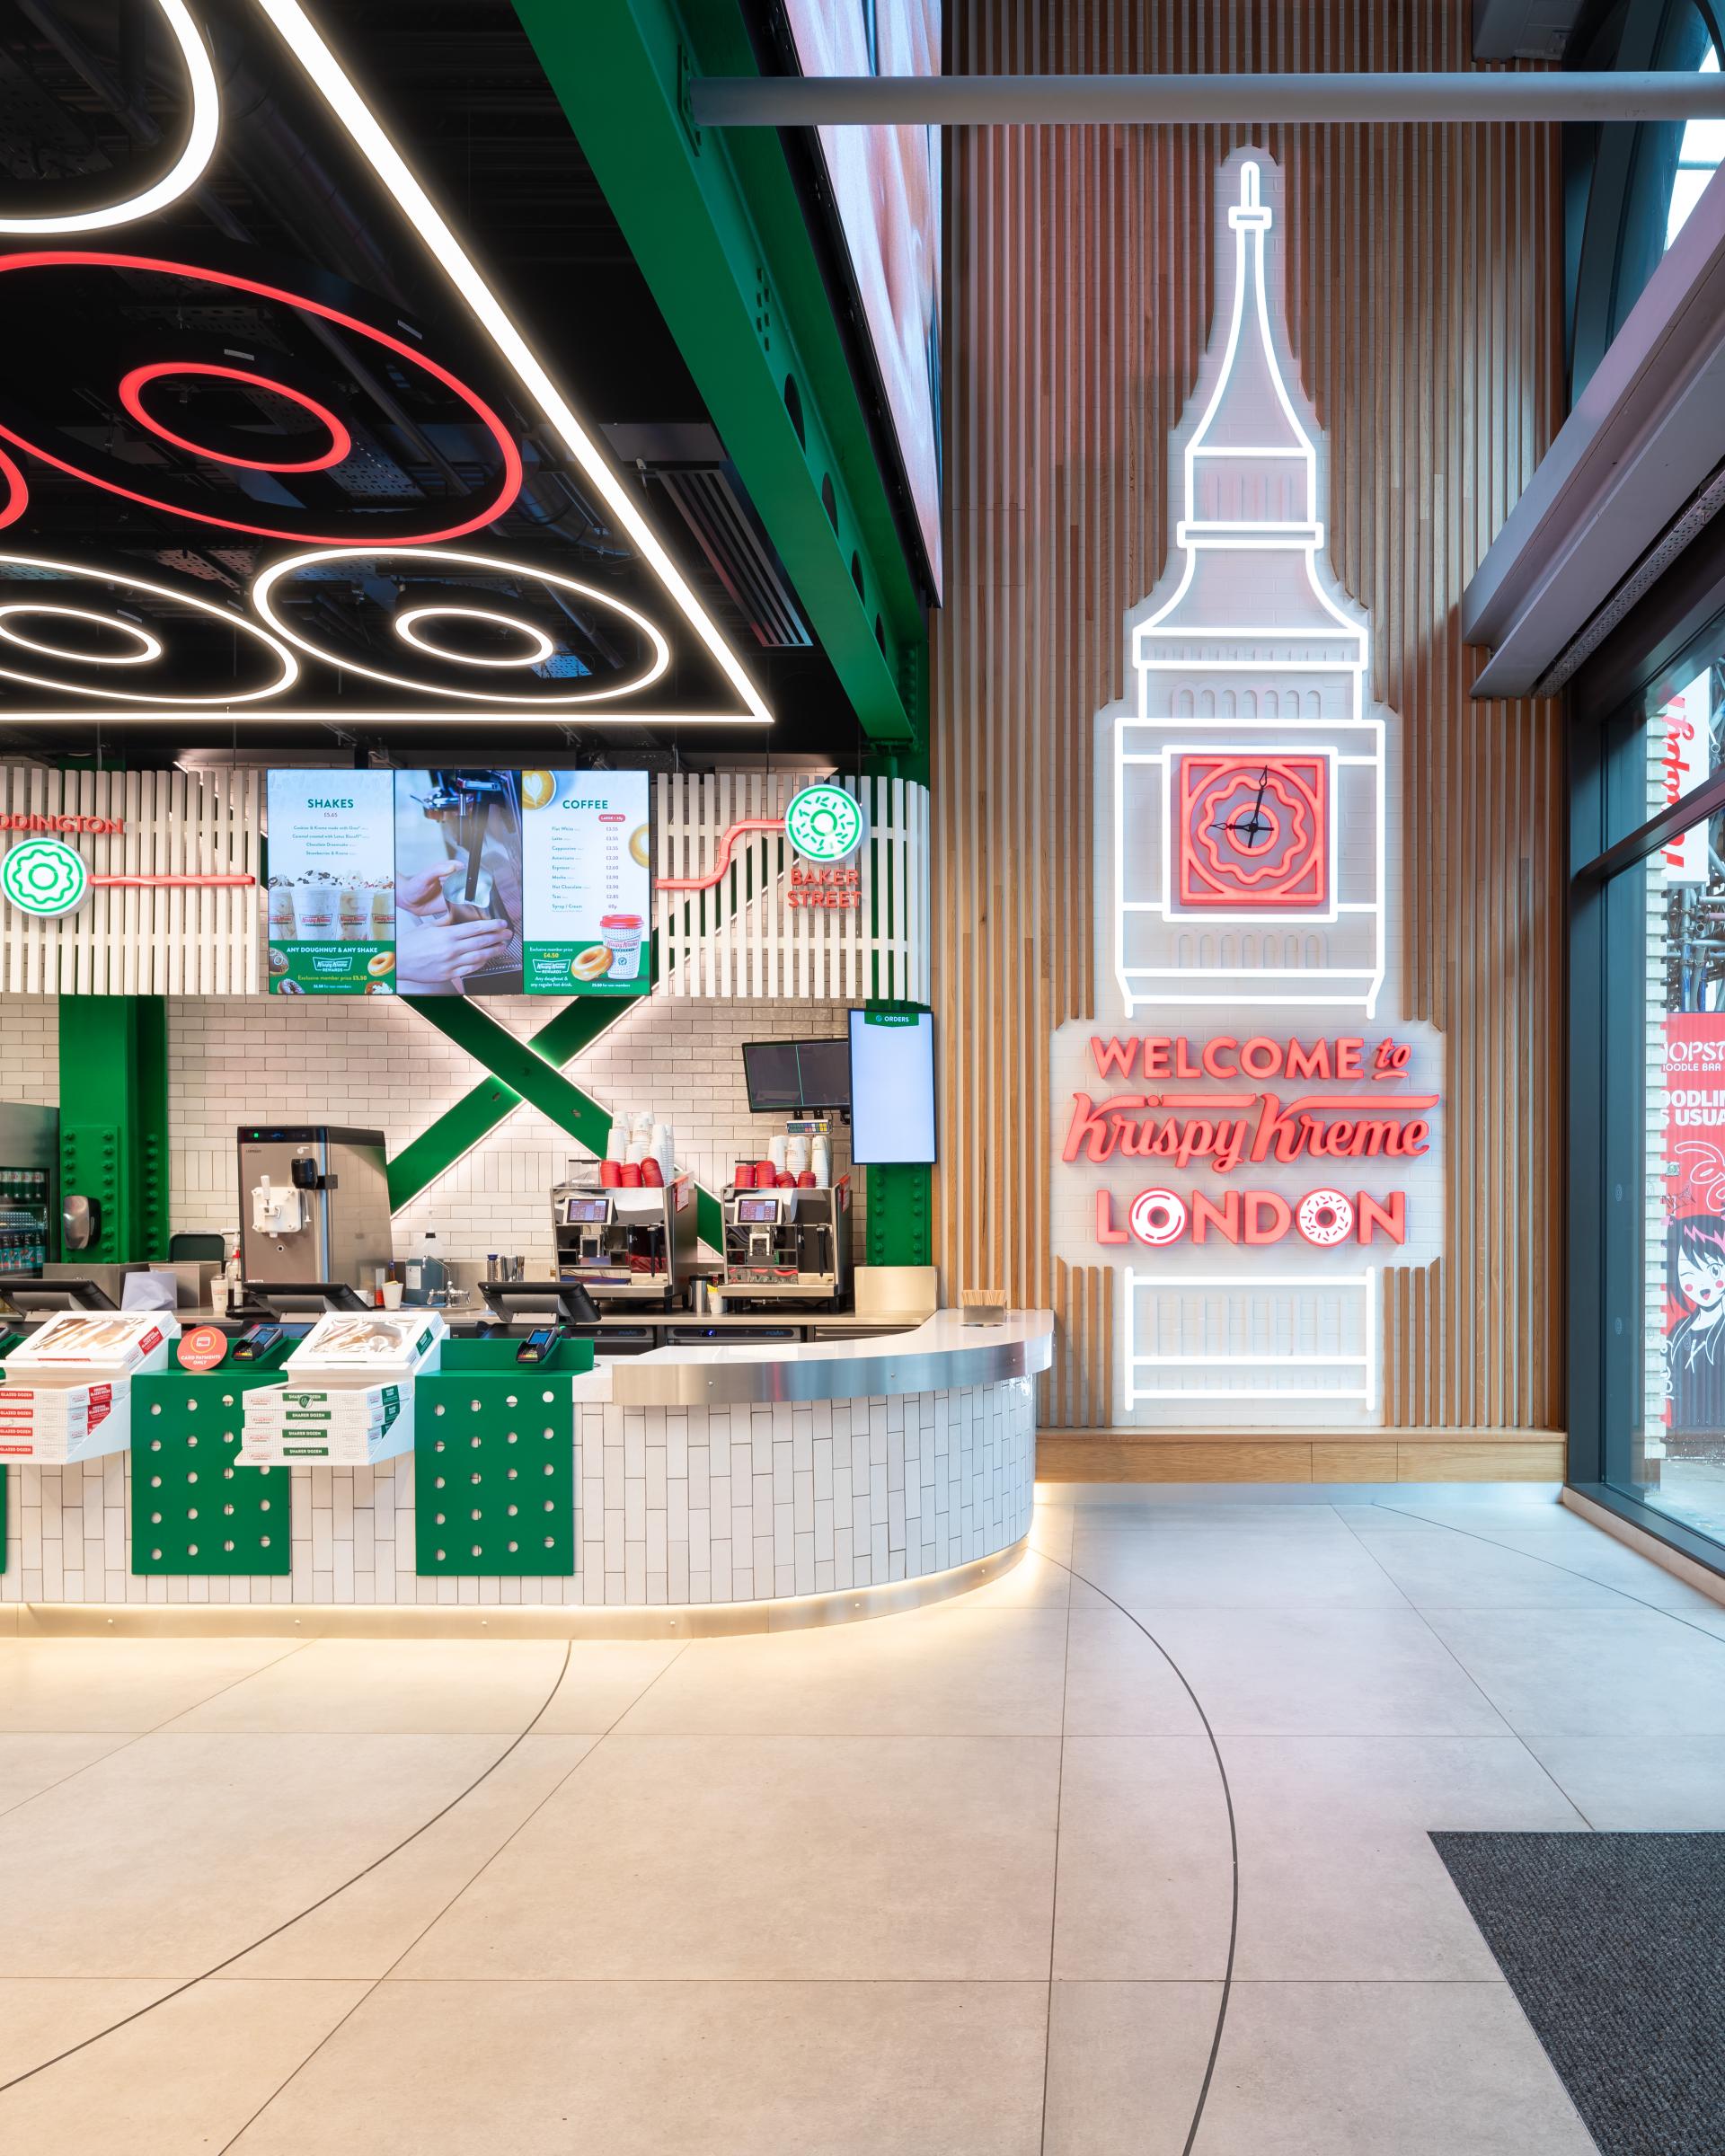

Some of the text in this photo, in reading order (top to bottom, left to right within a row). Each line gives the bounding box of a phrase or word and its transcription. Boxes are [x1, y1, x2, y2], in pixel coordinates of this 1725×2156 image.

[307, 799, 354, 808] SHAKES
[562, 800, 608, 808] COFFEE
[791, 868, 859, 887] BAKER
[787, 890, 862, 908] STREET
[1090, 1036, 1412, 1079] WELCOME to
[1702, 1063, 1721, 1071] BAR
[1062, 1092, 1440, 1173] Krispy Kreme
[1096, 1187, 1405, 1248] LONDON
